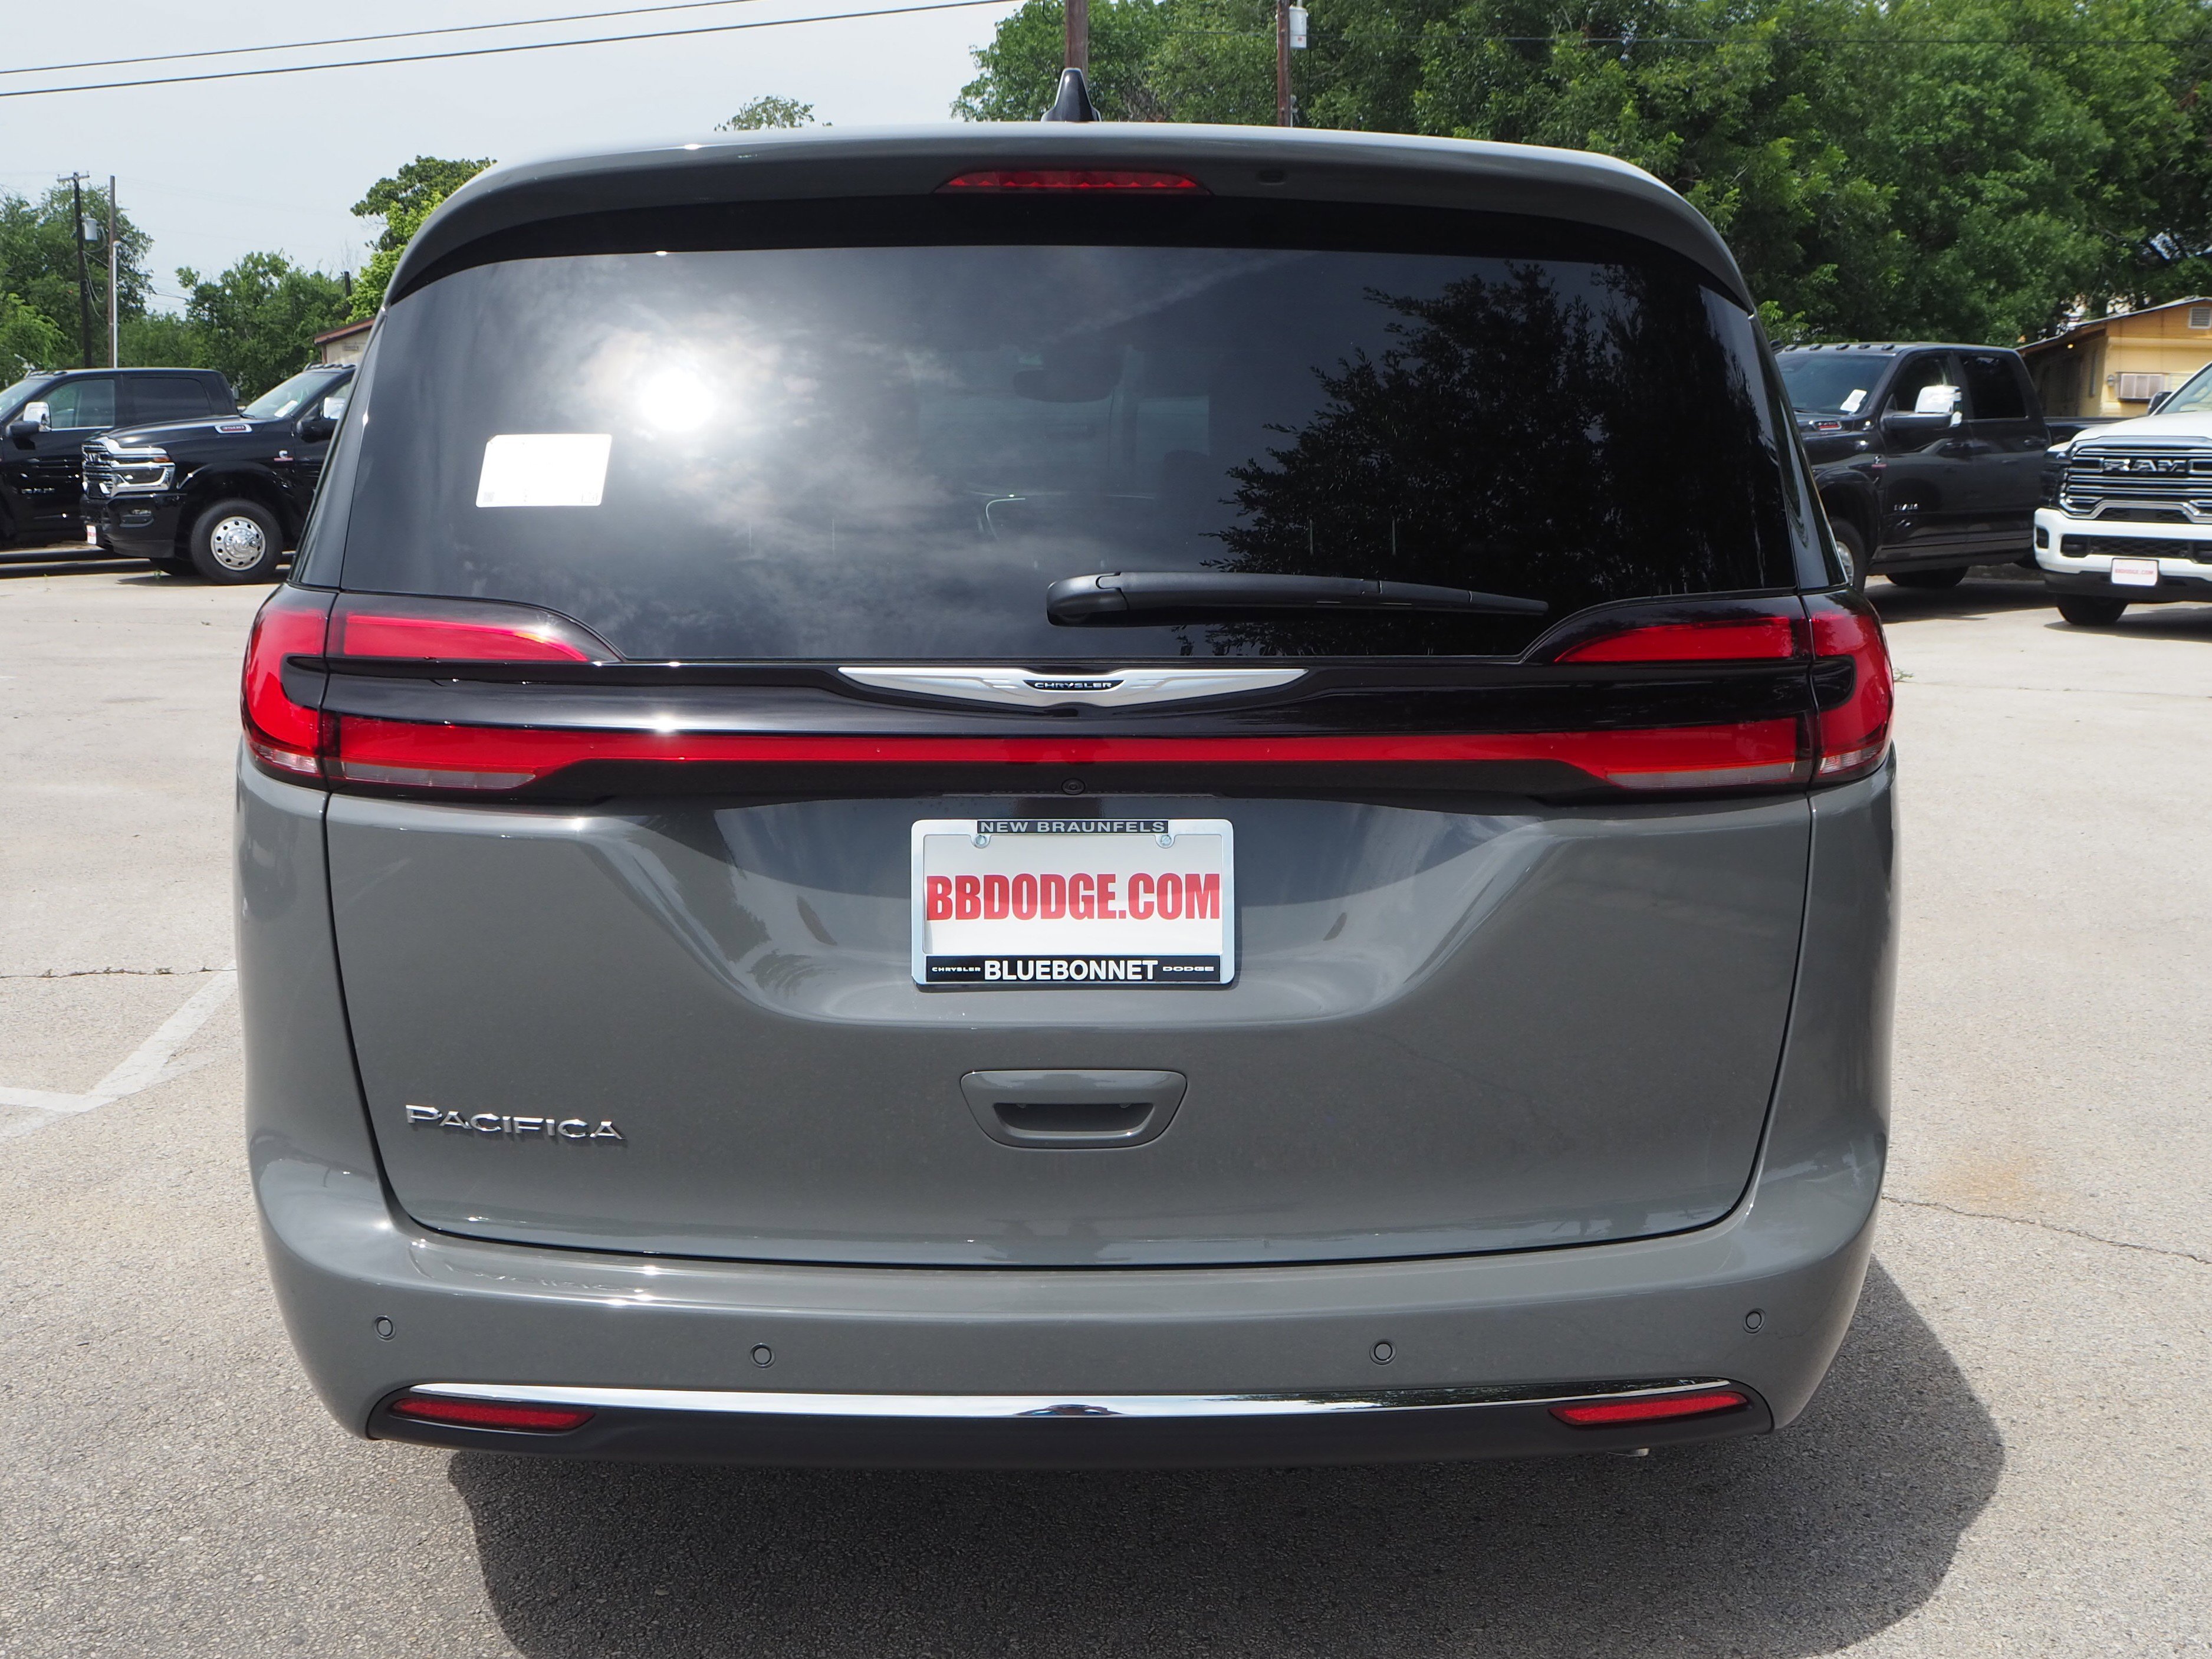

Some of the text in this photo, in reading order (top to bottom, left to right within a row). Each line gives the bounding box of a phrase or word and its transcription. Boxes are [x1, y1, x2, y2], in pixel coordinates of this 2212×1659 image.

[2103, 458, 2187, 472] RAM
[980, 821, 1165, 833] NEW BRAUNFELS
[926, 873, 1220, 921] BBDODGE.COM
[984, 960, 1158, 981] BLUEBONNET
[405, 1104, 626, 1140] PACIFICA
